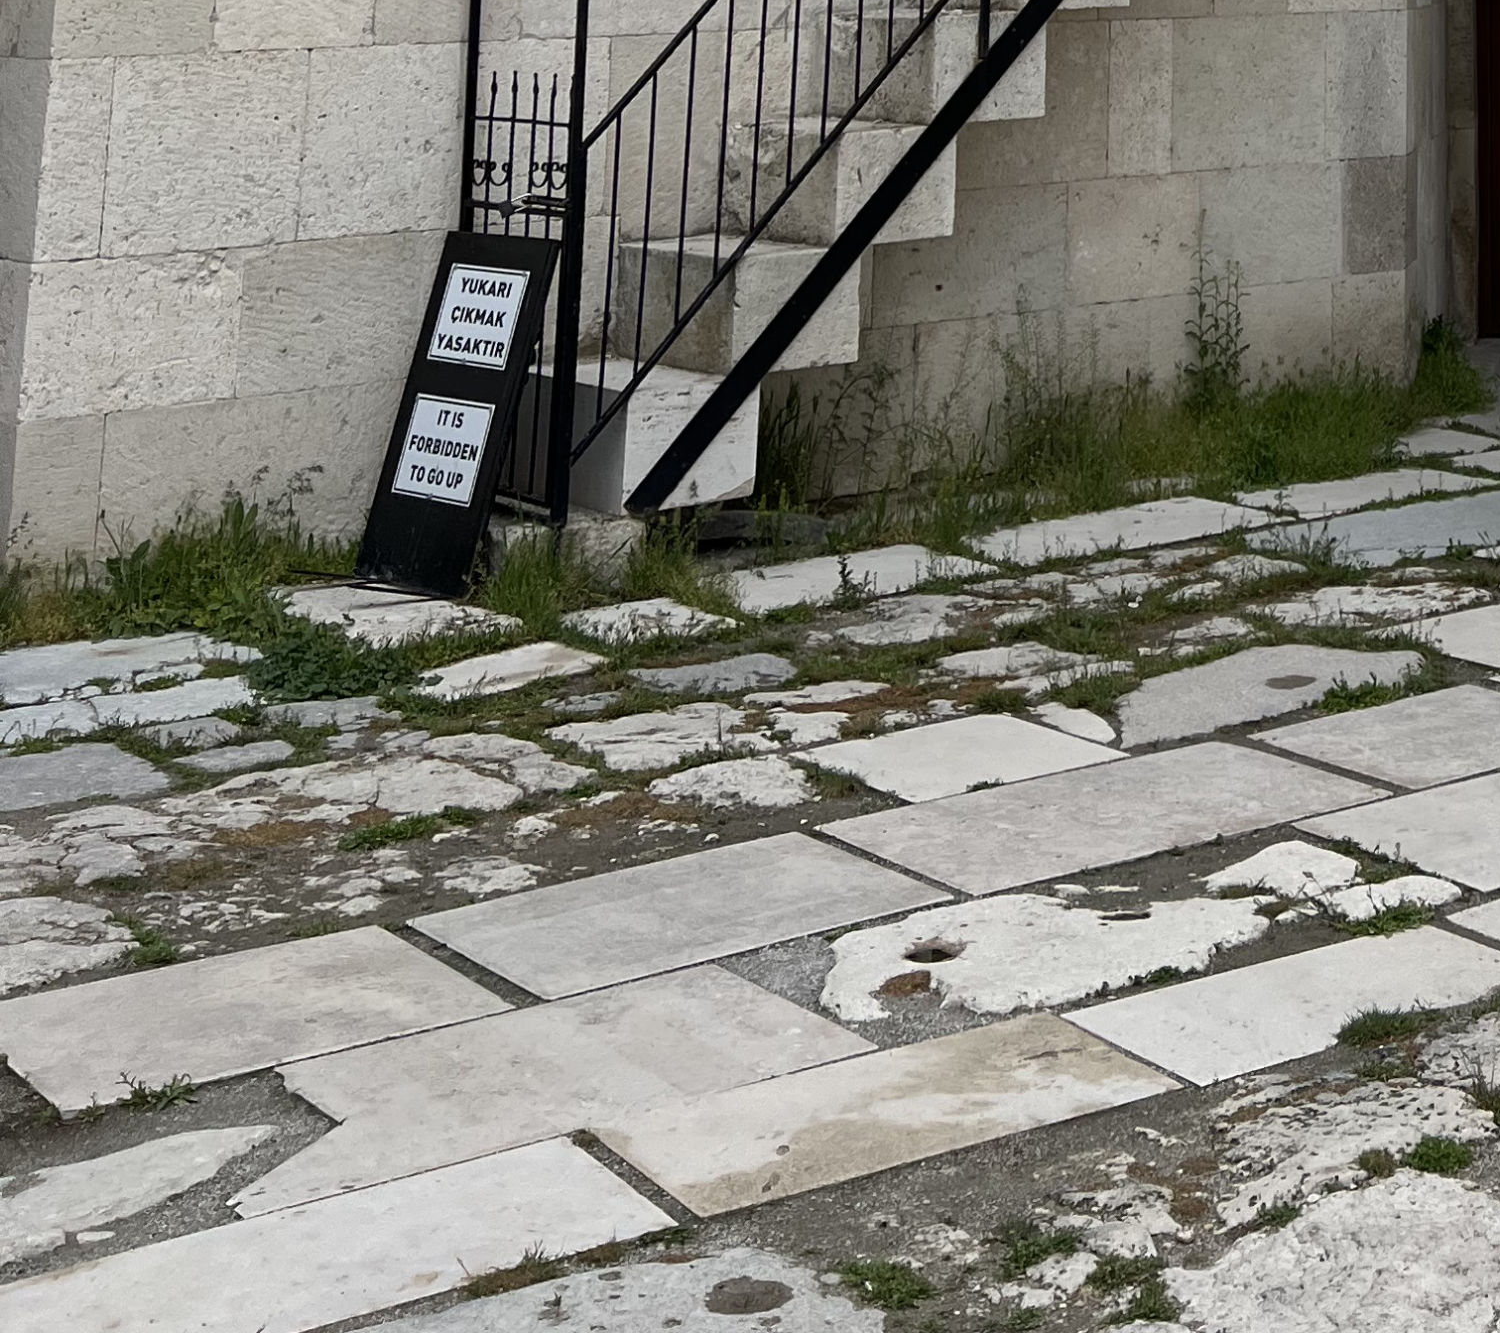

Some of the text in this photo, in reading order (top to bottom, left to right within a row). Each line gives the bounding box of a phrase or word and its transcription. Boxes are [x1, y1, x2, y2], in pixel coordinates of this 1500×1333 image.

[461, 276, 511, 298] YUKARI
[451, 306, 506, 327] ÇIKMAK
[438, 334, 504, 359] YASAKTIR
[437, 410, 463, 428] IT IS
[409, 435, 479, 461] FORBIDDEN
[410, 465, 463, 490] TO GO UP
